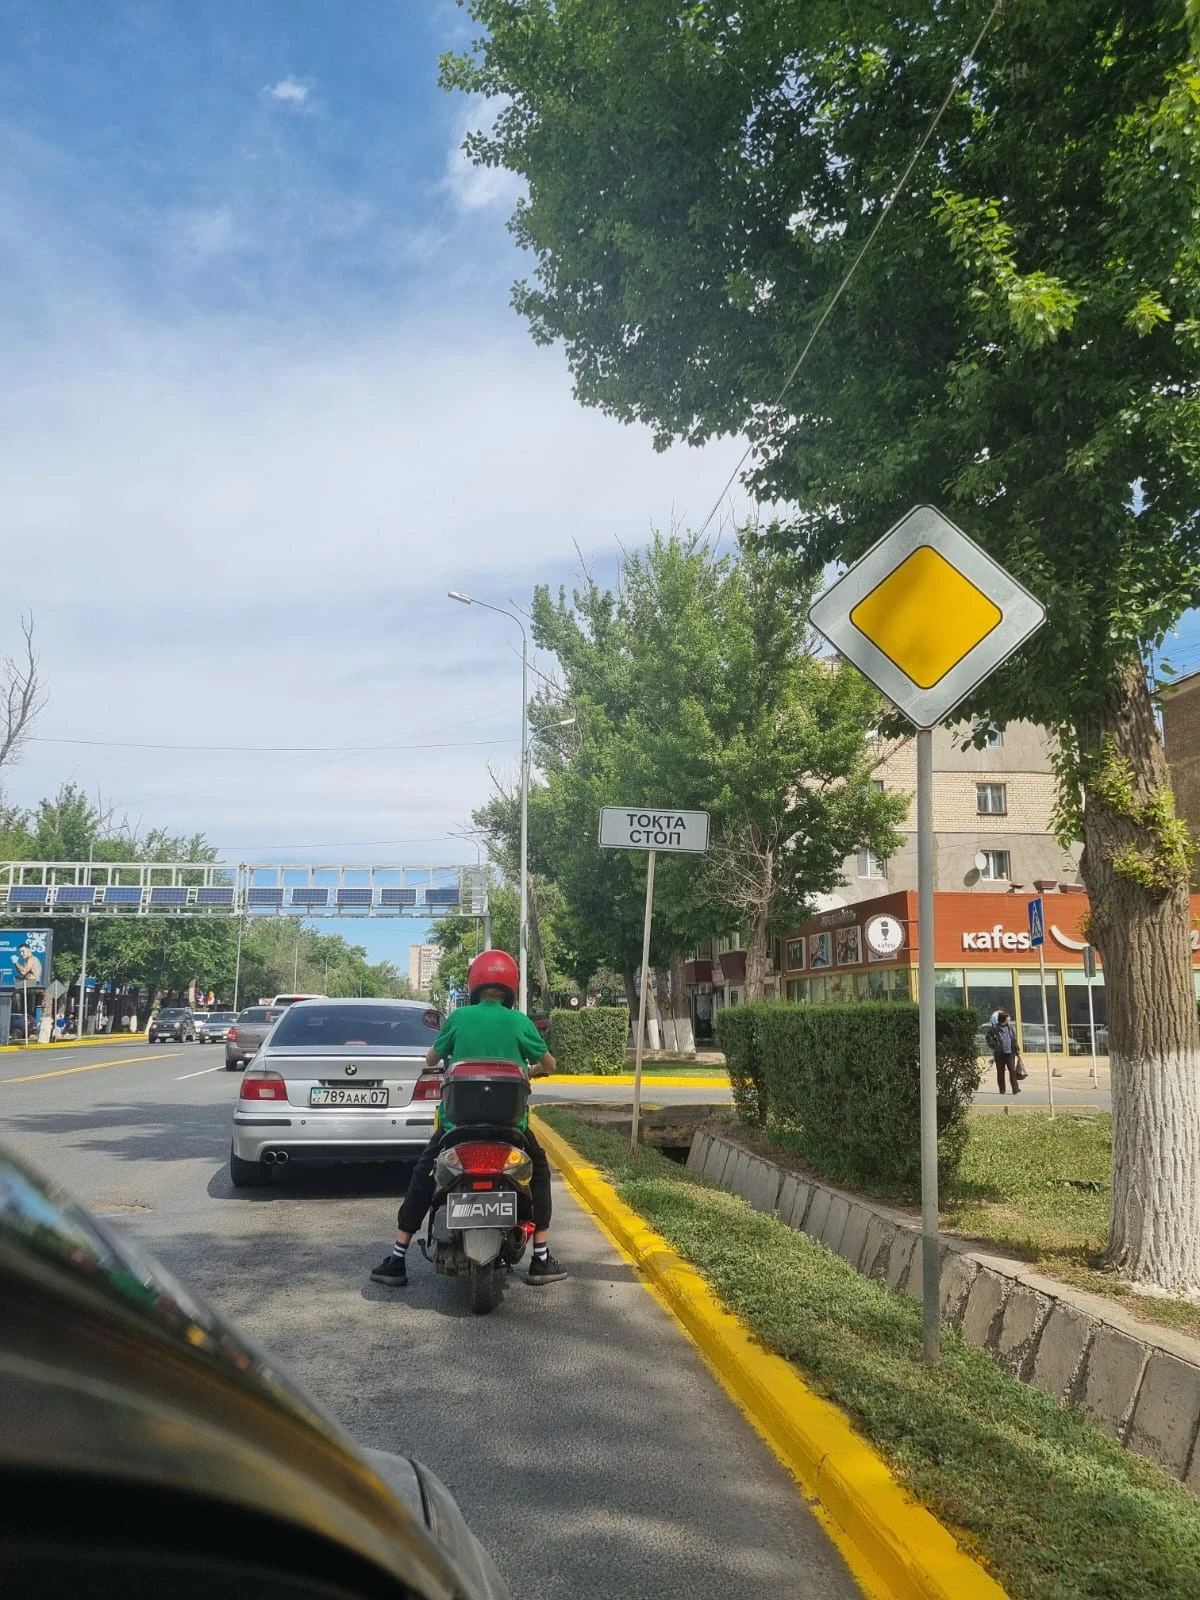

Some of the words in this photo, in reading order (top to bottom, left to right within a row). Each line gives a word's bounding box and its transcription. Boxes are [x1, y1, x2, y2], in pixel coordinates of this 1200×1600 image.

[627, 813, 686, 831] ТОҚТА
[629, 829, 681, 845] СТОП
[962, 924, 1037, 949] kafes
[323, 1090, 367, 1103] 789AAK
[371, 1091, 386, 1103] 07
[470, 1203, 513, 1217] AMG
